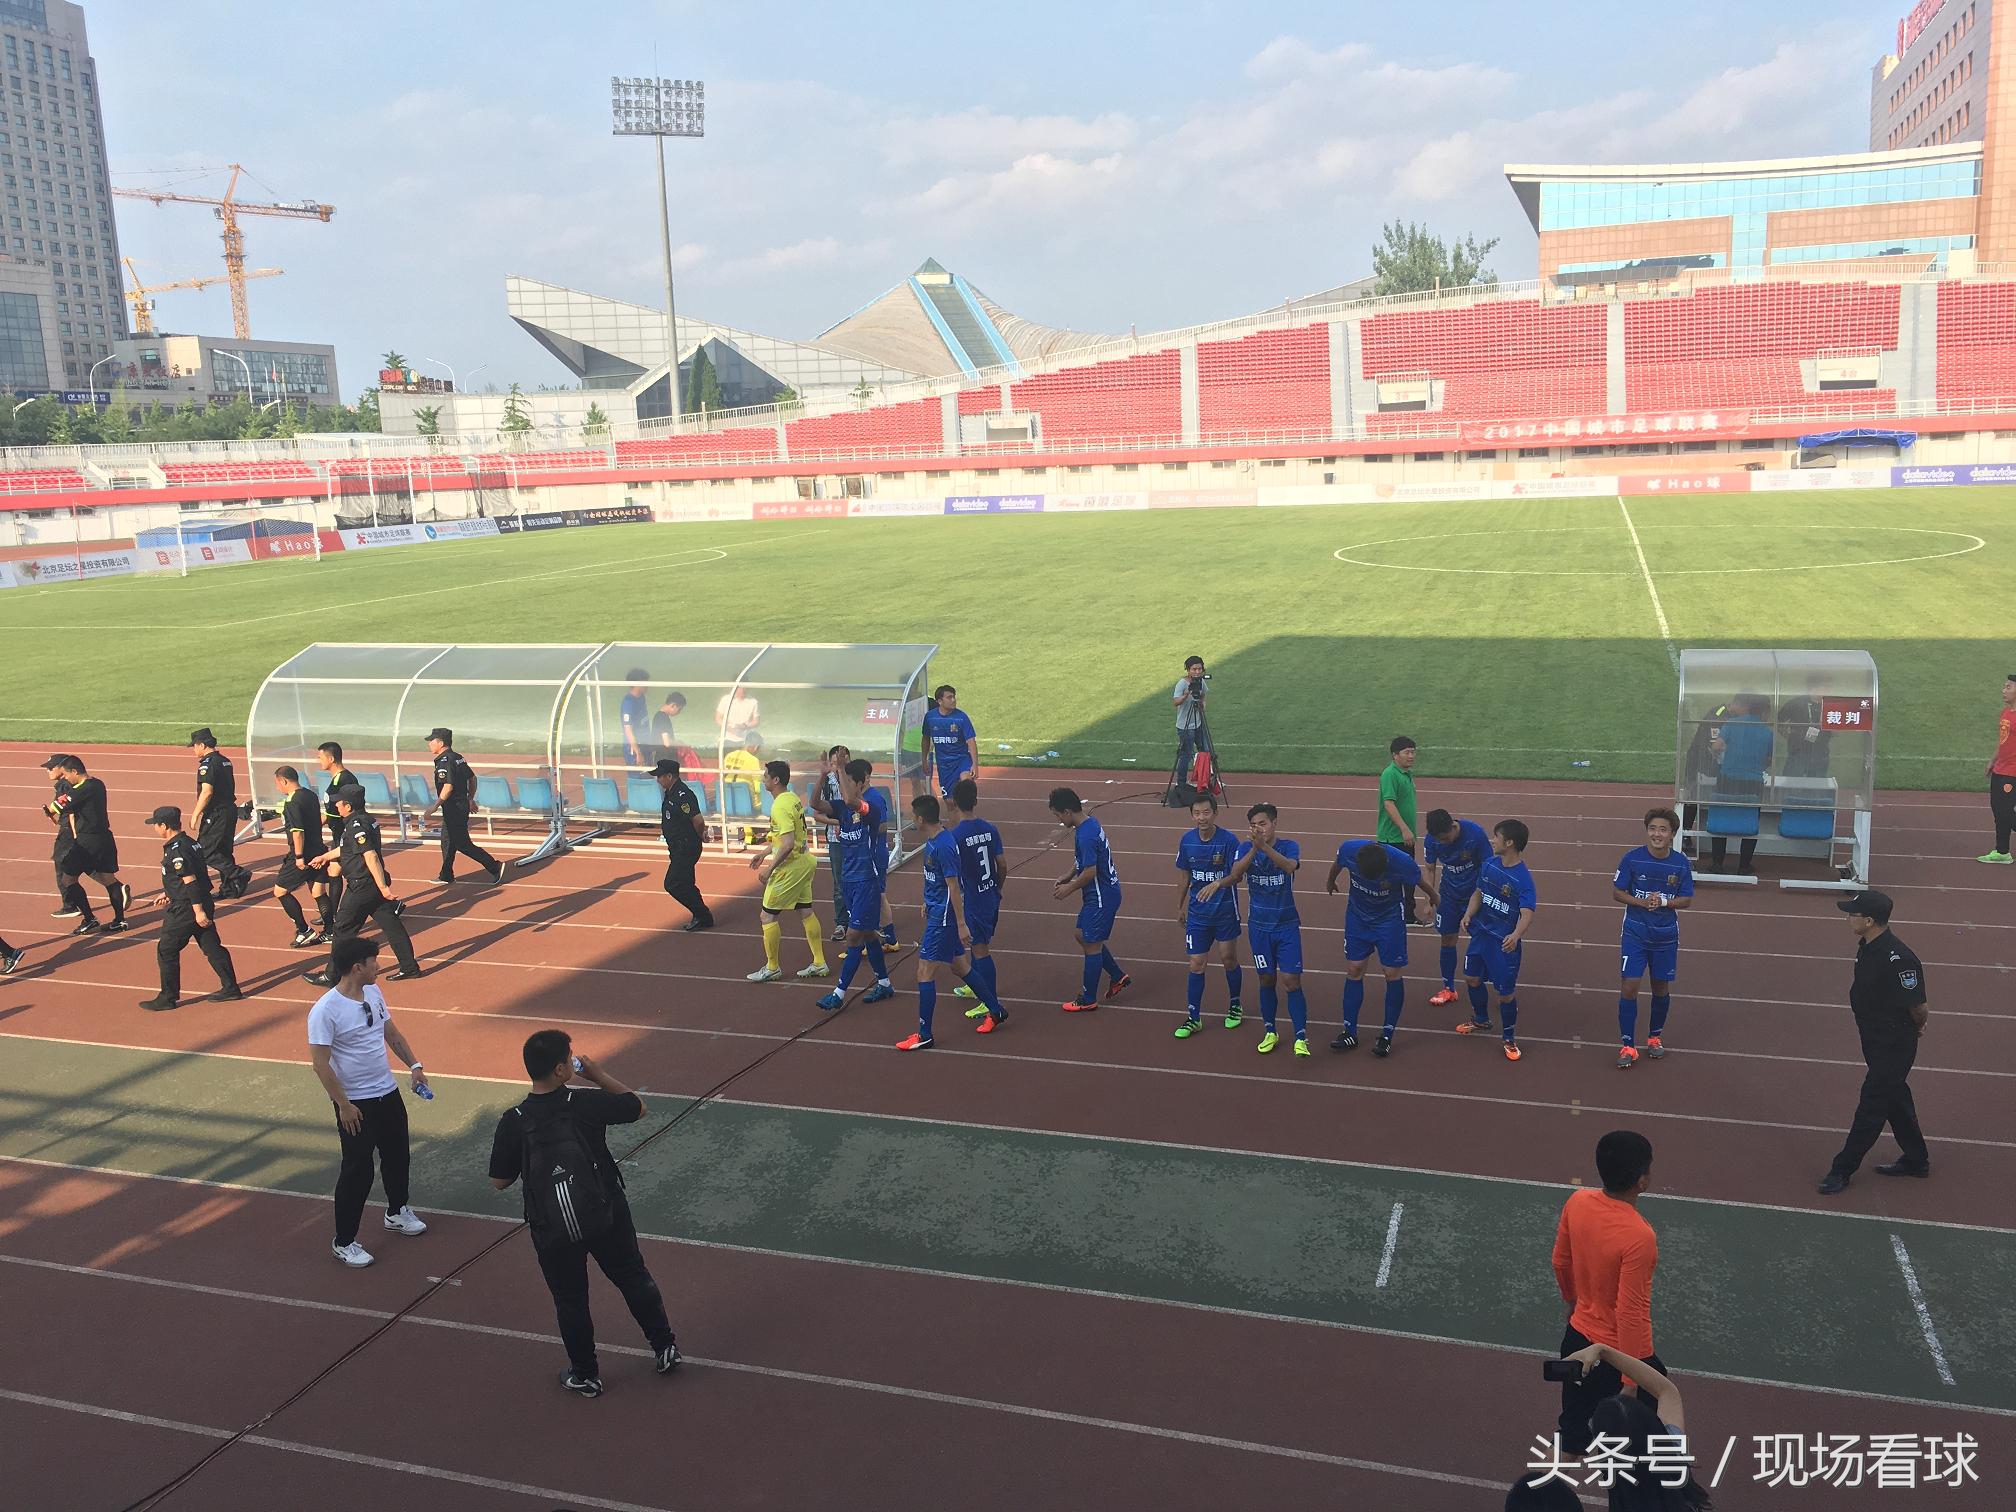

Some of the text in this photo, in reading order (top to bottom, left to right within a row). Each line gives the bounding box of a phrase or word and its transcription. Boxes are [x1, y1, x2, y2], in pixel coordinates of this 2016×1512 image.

[1484, 413, 1719, 439] 2017中国城市足球联赛
[866, 709, 889, 719] 主队
[1826, 711, 1860, 725] 裁判
[976, 845, 991, 881] 3
[1254, 954, 1268, 969] 18
